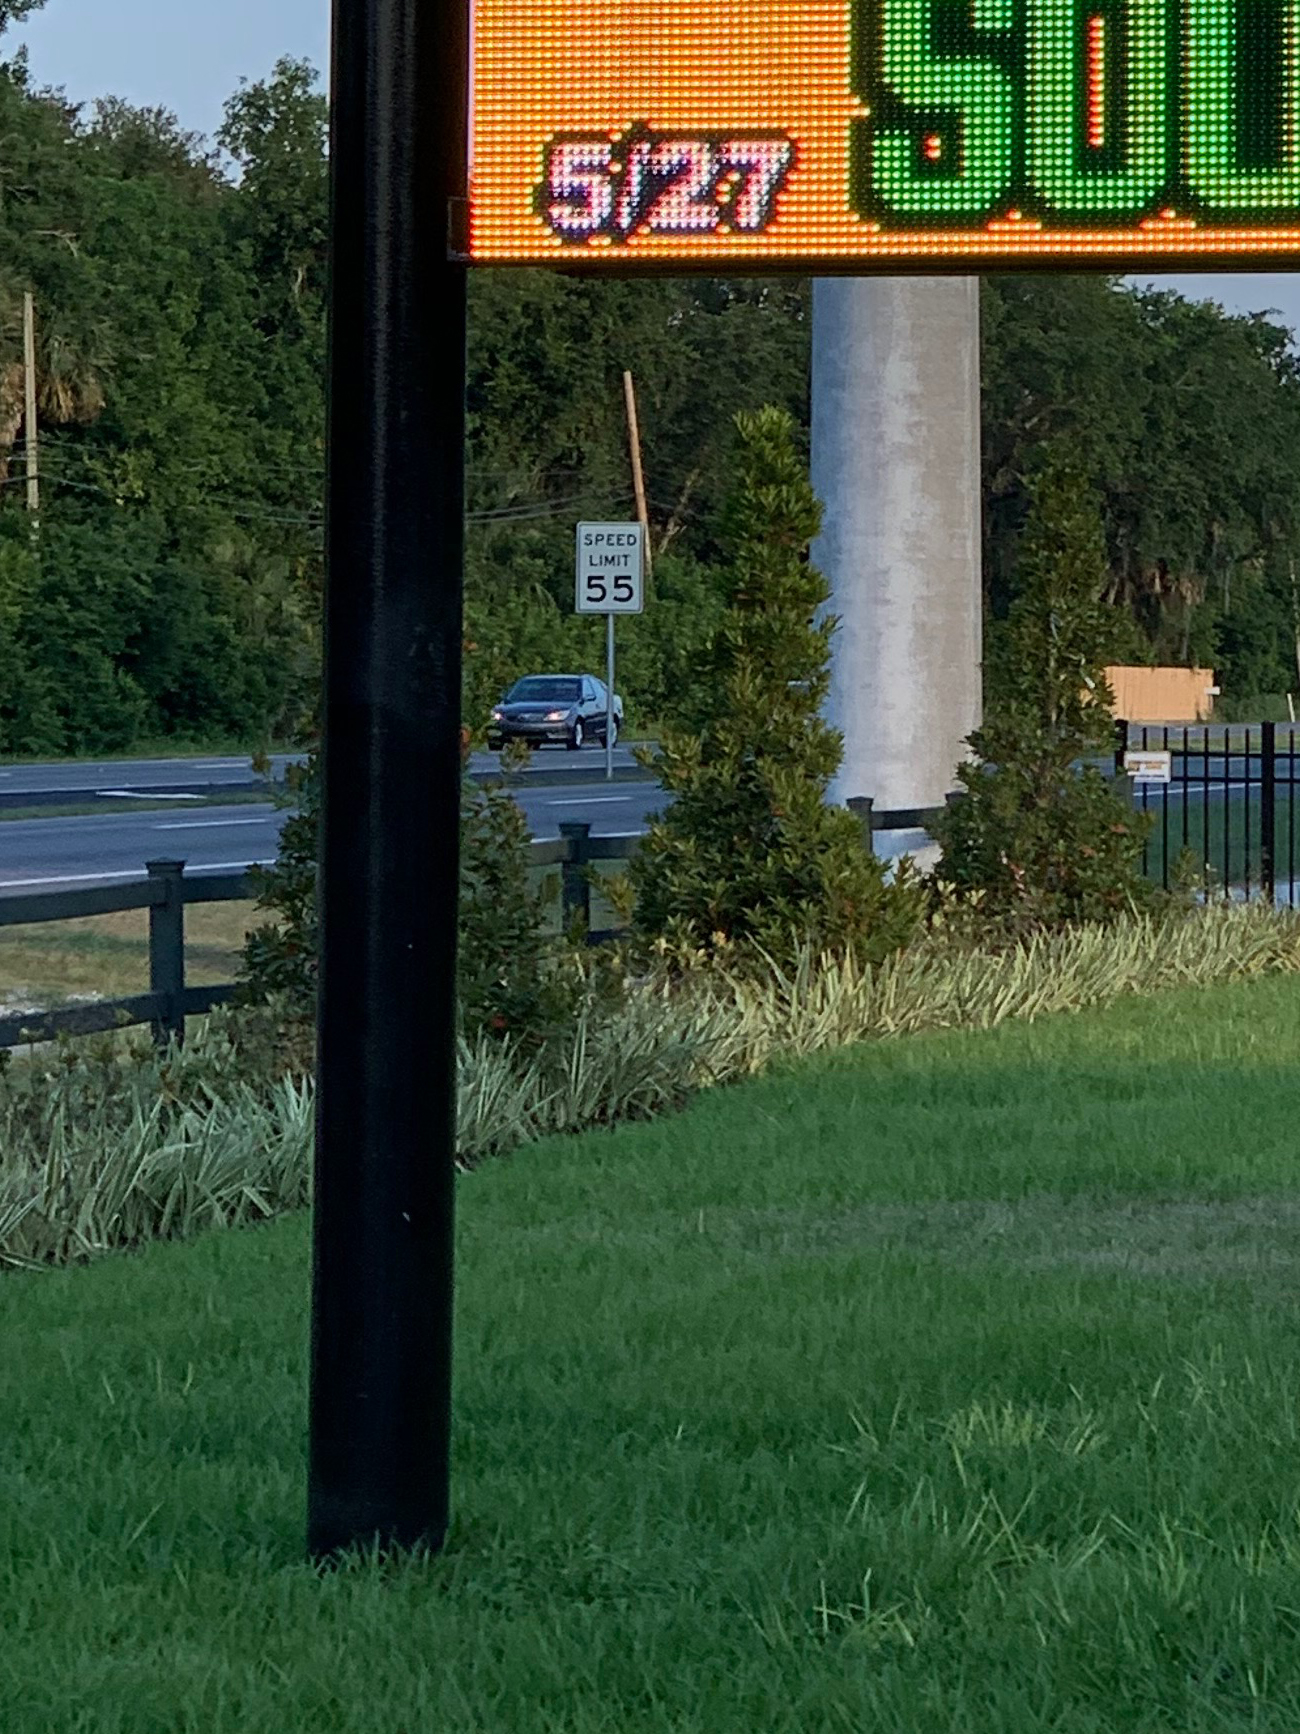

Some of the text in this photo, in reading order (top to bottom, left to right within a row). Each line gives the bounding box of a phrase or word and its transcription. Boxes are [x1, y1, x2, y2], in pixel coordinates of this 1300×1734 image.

[547, 138, 793, 230] 5/27
[583, 533, 637, 546] SPEED
[589, 554, 631, 567] LIMIT
[586, 575, 634, 603] 55
